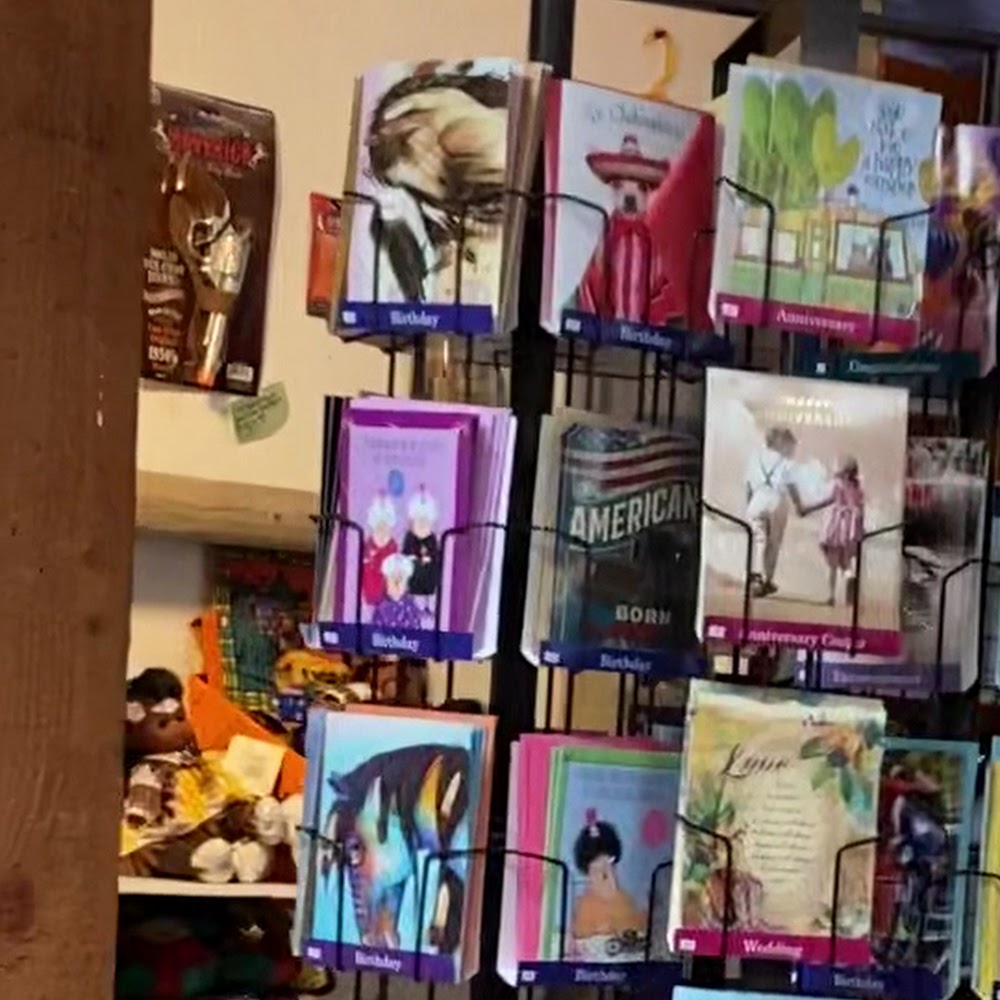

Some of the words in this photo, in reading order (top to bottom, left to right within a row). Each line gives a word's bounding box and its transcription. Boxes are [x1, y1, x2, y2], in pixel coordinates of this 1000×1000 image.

[389, 309, 440, 329] Birthday
[776, 307, 857, 334] Anniversary
[569, 483, 701, 544] AMERICAN
[614, 604, 673, 625] BORN
[371, 631, 421, 652] Birthday
[354, 950, 402, 972] Birthday
